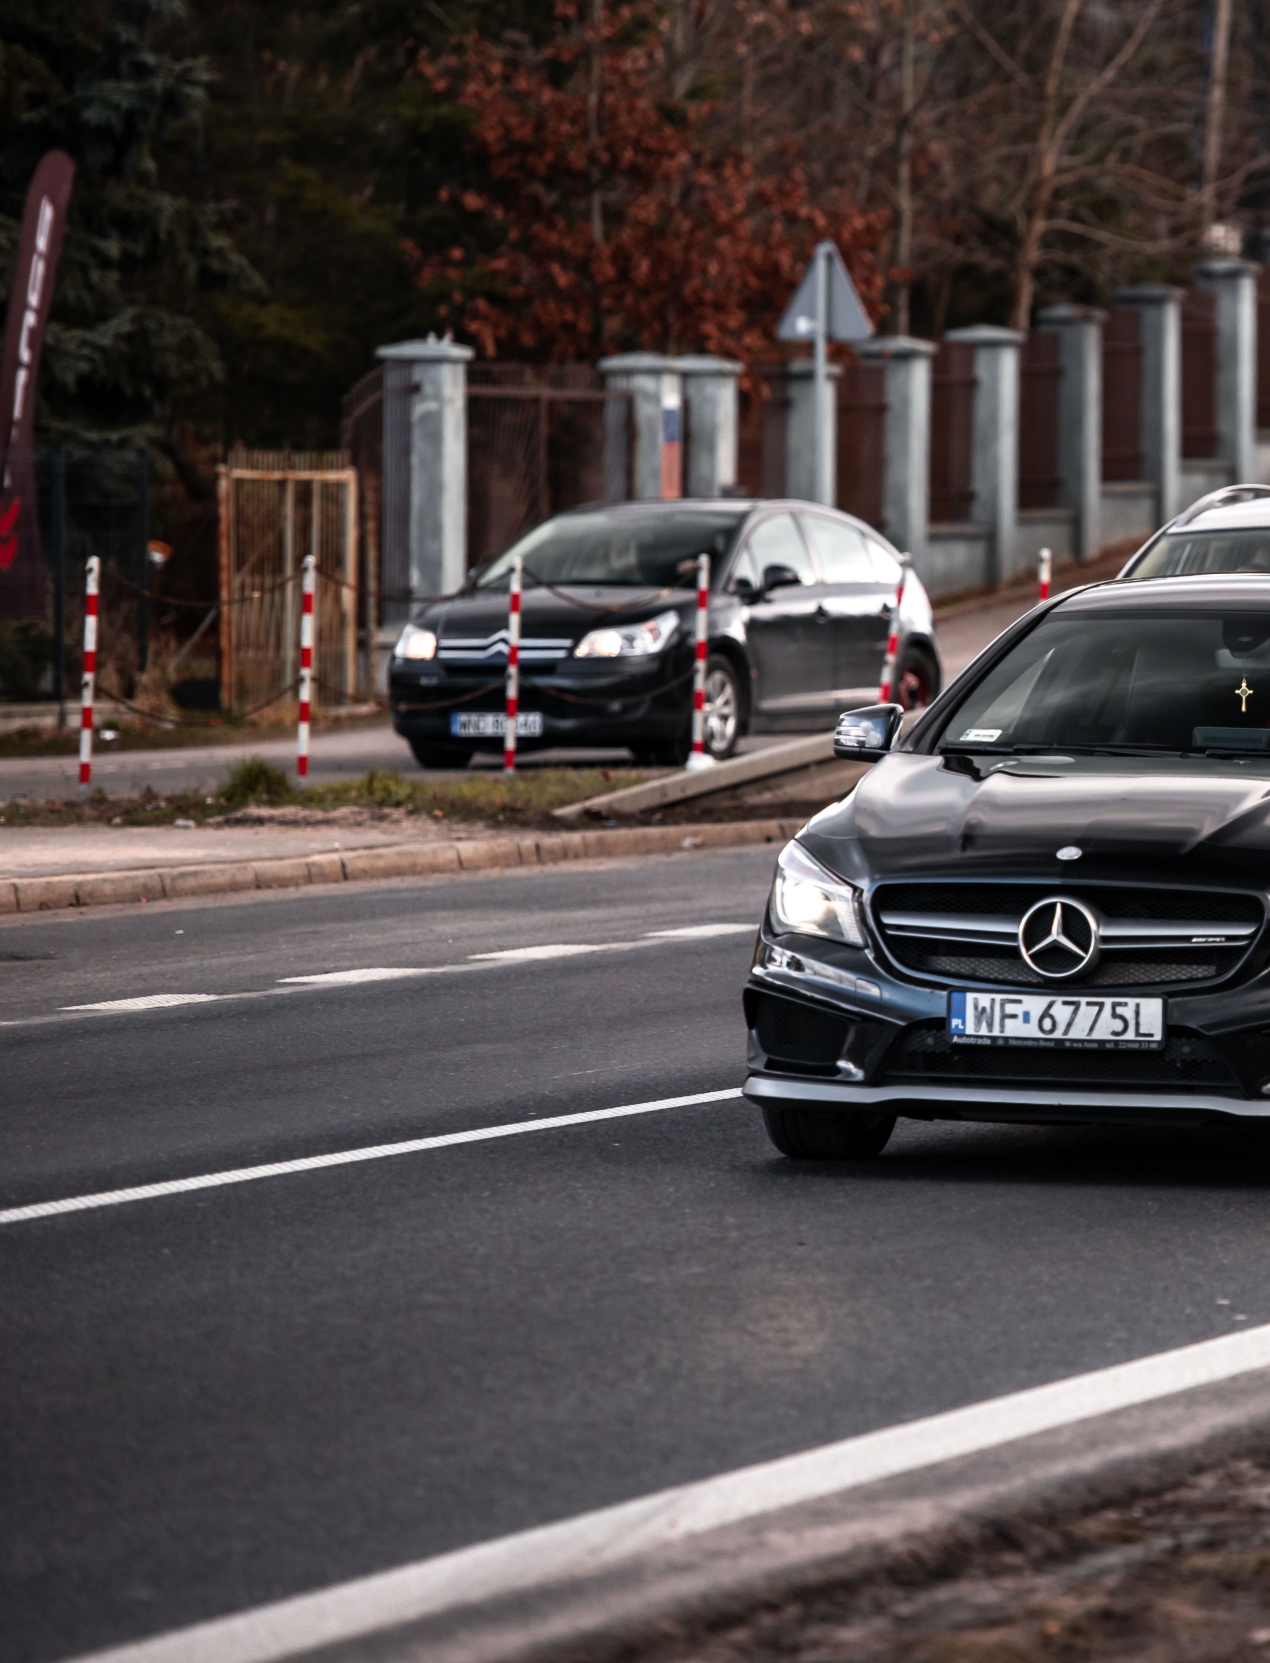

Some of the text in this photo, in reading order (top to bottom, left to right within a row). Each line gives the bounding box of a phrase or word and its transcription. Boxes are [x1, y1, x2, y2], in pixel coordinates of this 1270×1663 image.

[972, 997, 1155, 1038] WF 6775L
[951, 1018, 964, 1029] PL
[952, 1035, 991, 1045] Autotrade
